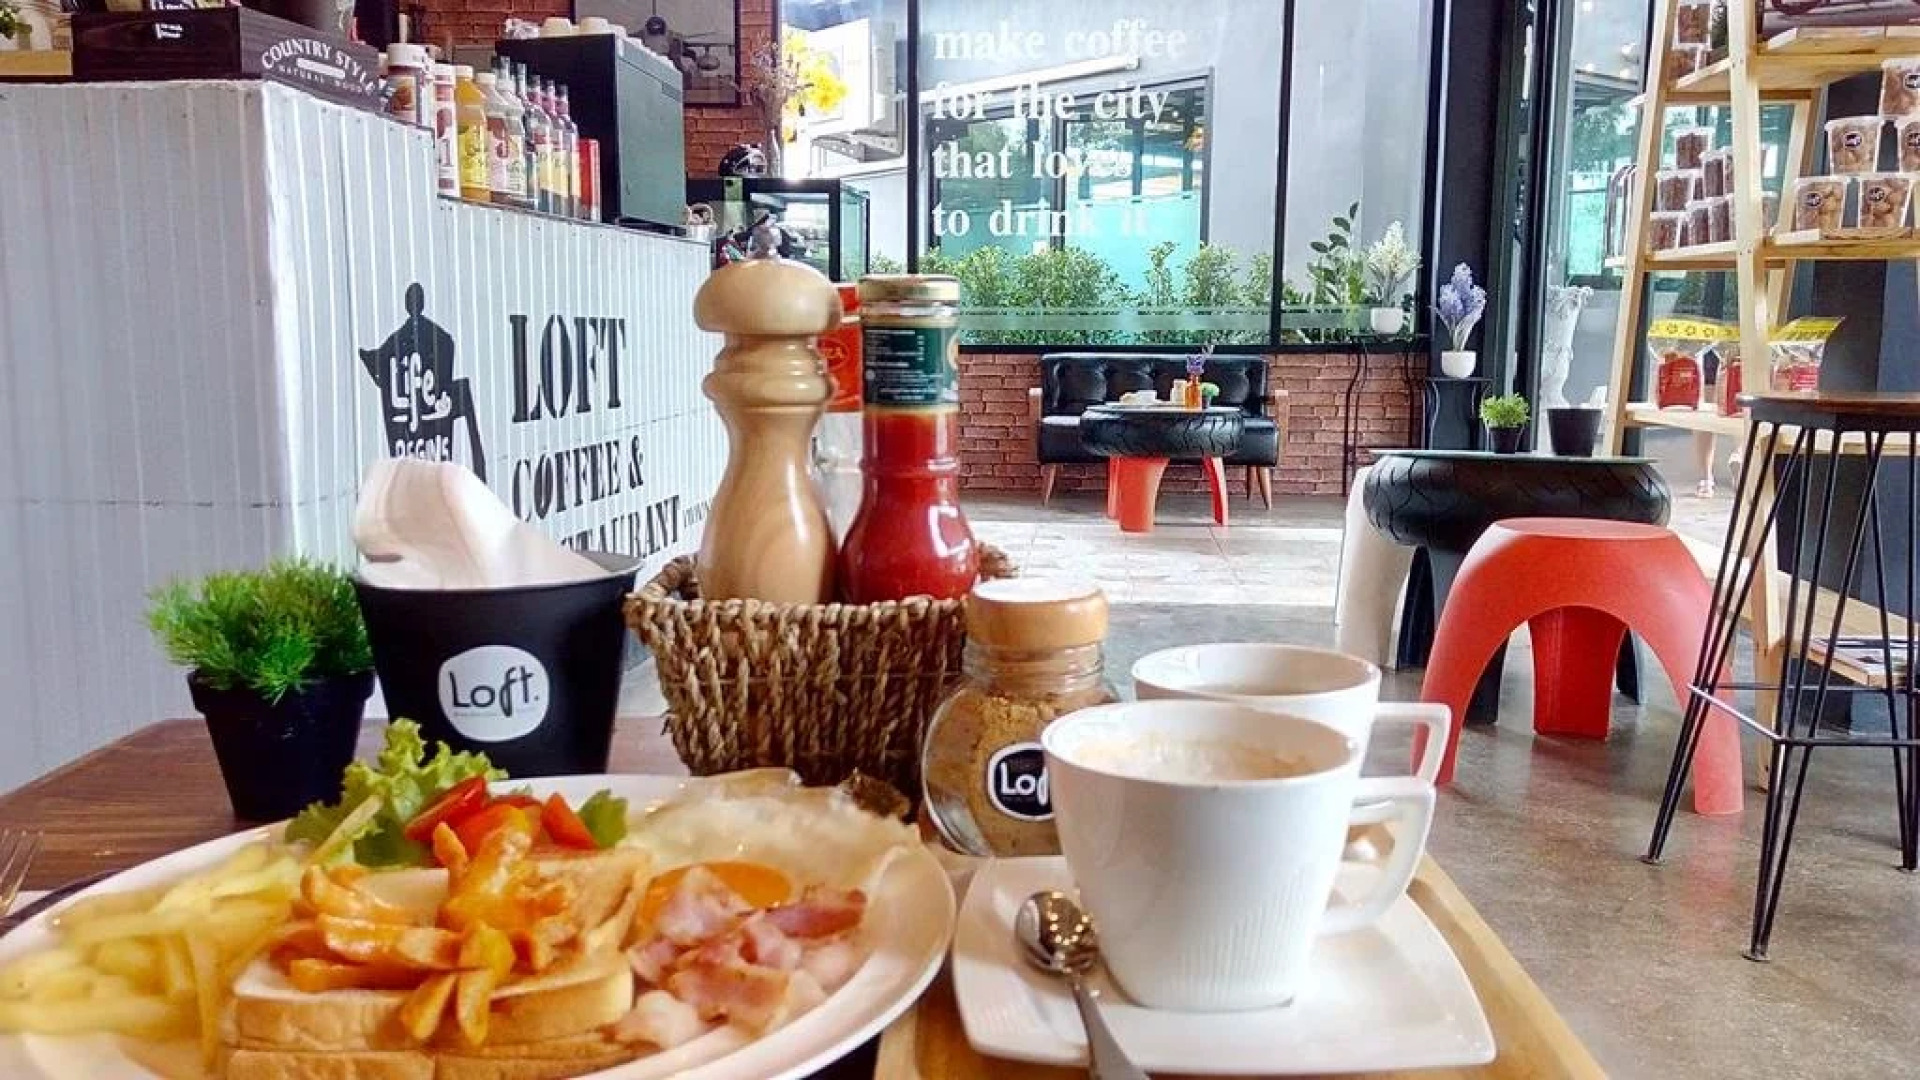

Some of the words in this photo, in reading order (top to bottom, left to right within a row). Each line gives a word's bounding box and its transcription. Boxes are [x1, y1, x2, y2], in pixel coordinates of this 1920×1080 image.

[261, 39, 332, 69] COUNTRY
[933, 21, 1045, 60] make
[1064, 18, 1188, 58] coffee
[932, 82, 990, 119] for
[1013, 83, 1076, 119] the
[1094, 80, 1180, 124] city.
[932, 141, 1014, 179] that
[932, 201, 971, 237] to
[989, 199, 1095, 237] drink
[510, 315, 627, 424] LOFT
[389, 352, 436, 433] Life
[511, 440, 621, 522] COFFEE
[628, 435, 645, 489] &
[1000, 762, 1049, 806] Lof
